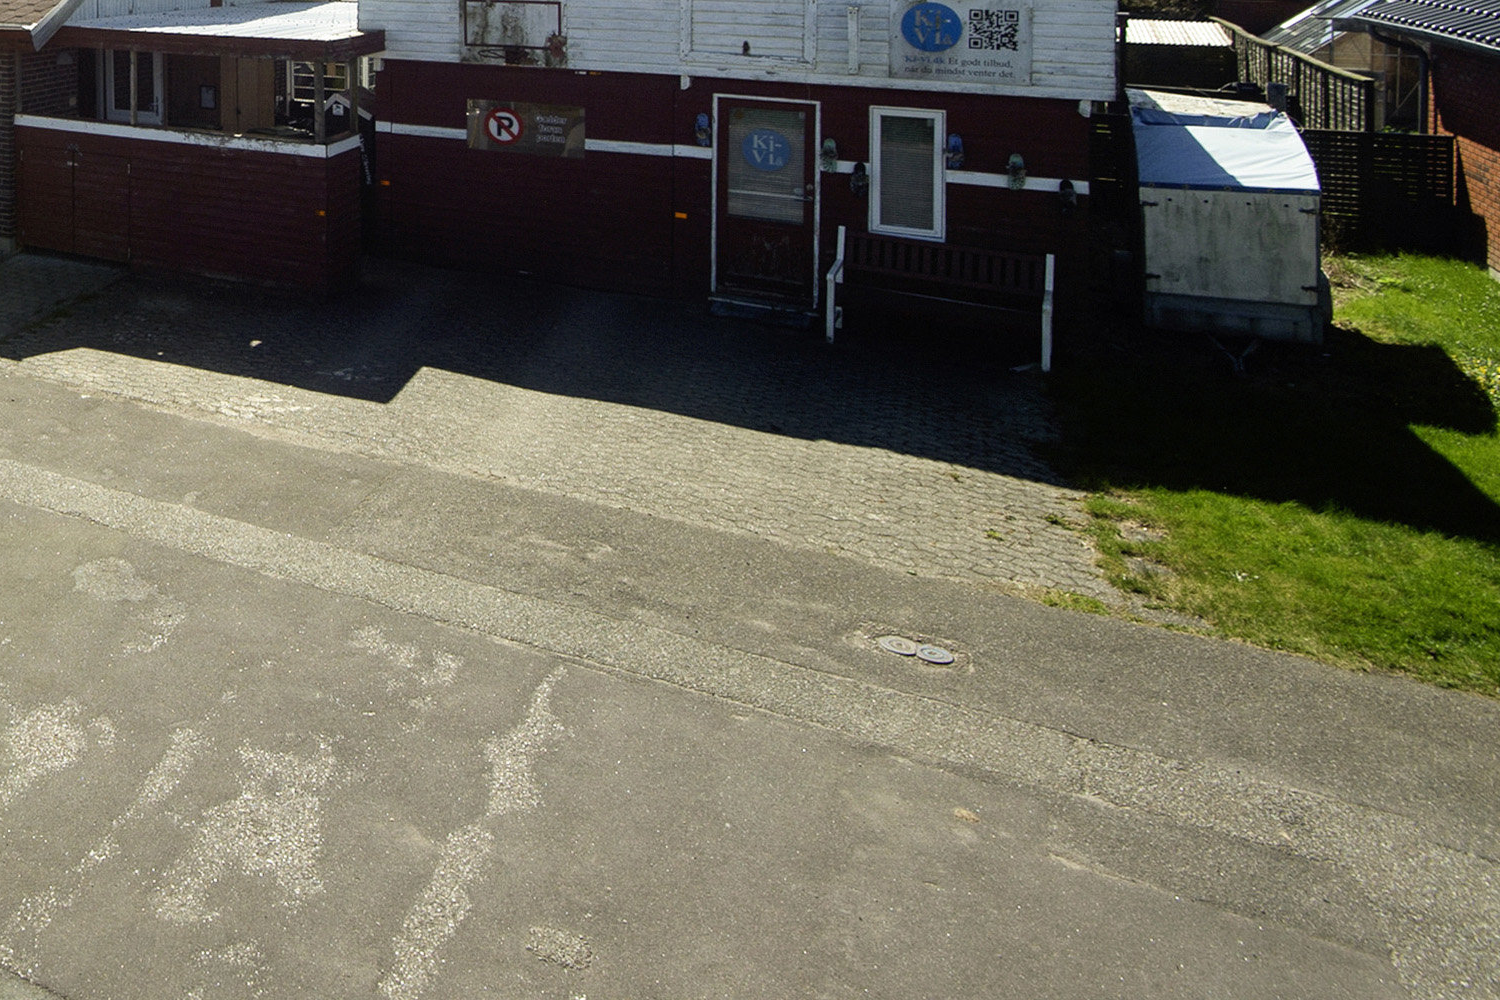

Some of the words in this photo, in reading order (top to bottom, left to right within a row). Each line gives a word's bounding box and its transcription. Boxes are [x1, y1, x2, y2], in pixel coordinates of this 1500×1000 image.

[960, 59, 981, 67] godt
[935, 66, 965, 75] mindst
[968, 69, 997, 77] venter
